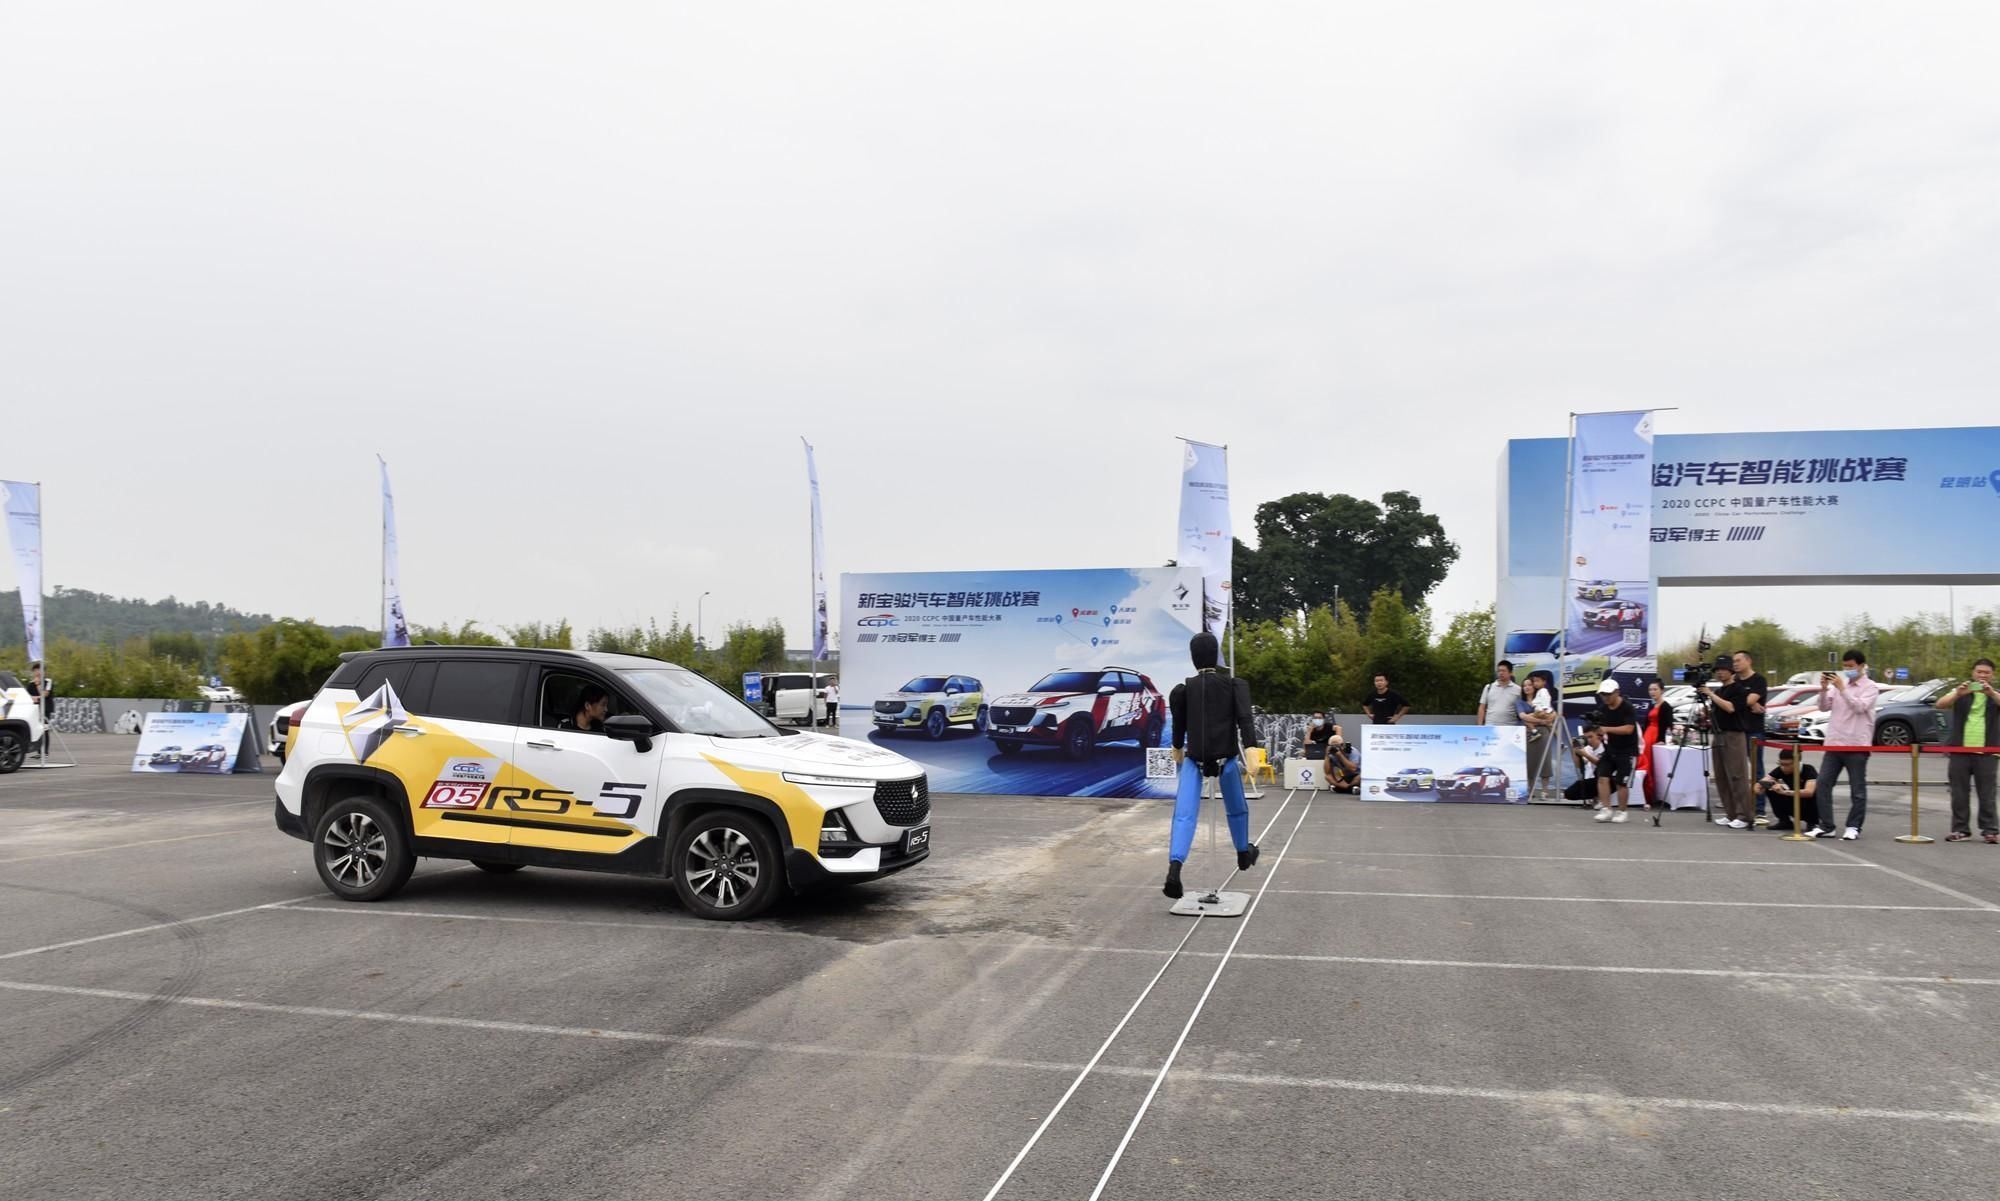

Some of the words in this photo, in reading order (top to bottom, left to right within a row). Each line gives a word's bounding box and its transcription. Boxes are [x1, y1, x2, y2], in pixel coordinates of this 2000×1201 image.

[1662, 499, 1690, 508] 2020
[1694, 498, 1726, 508] CCPC
[1730, 495, 1839, 508] 中国量产车性能大赛
[857, 591, 1041, 608] 新宝骏汽车智能挑战赛
[432, 787, 481, 805] 05
[485, 782, 647, 818] RS-5
[910, 830, 929, 847] RS-5
